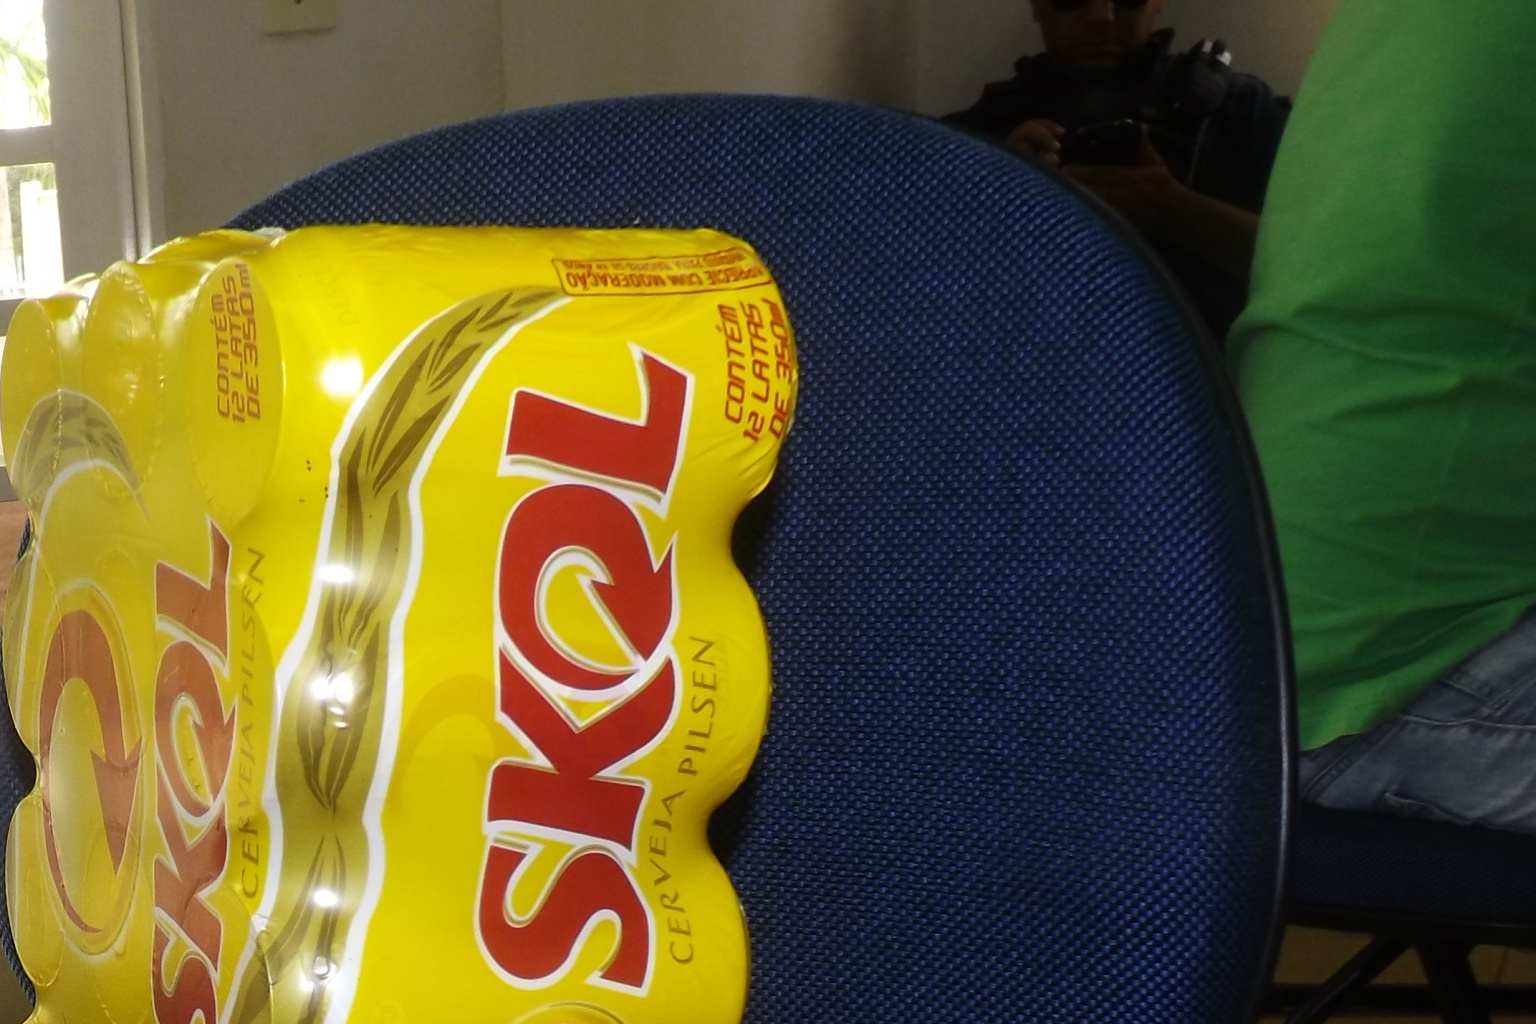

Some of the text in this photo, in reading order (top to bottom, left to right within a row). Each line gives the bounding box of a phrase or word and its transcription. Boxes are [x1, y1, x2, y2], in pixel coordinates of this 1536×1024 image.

[222, 275, 246, 424] 12 LATAS
[235, 262, 261, 421] DE 350ml
[565, 271, 666, 291] MODERAÇÃO
[210, 293, 231, 419] CONTÉM
[715, 303, 746, 424] CONTÉM
[740, 300, 771, 442] 12 LATAS
[769, 392, 791, 440] DE
[238, 546, 266, 899] CERVEJA PILSEN
[474, 341, 695, 997] SKOL
[647, 635, 718, 966] CERVEJA PILSEN
